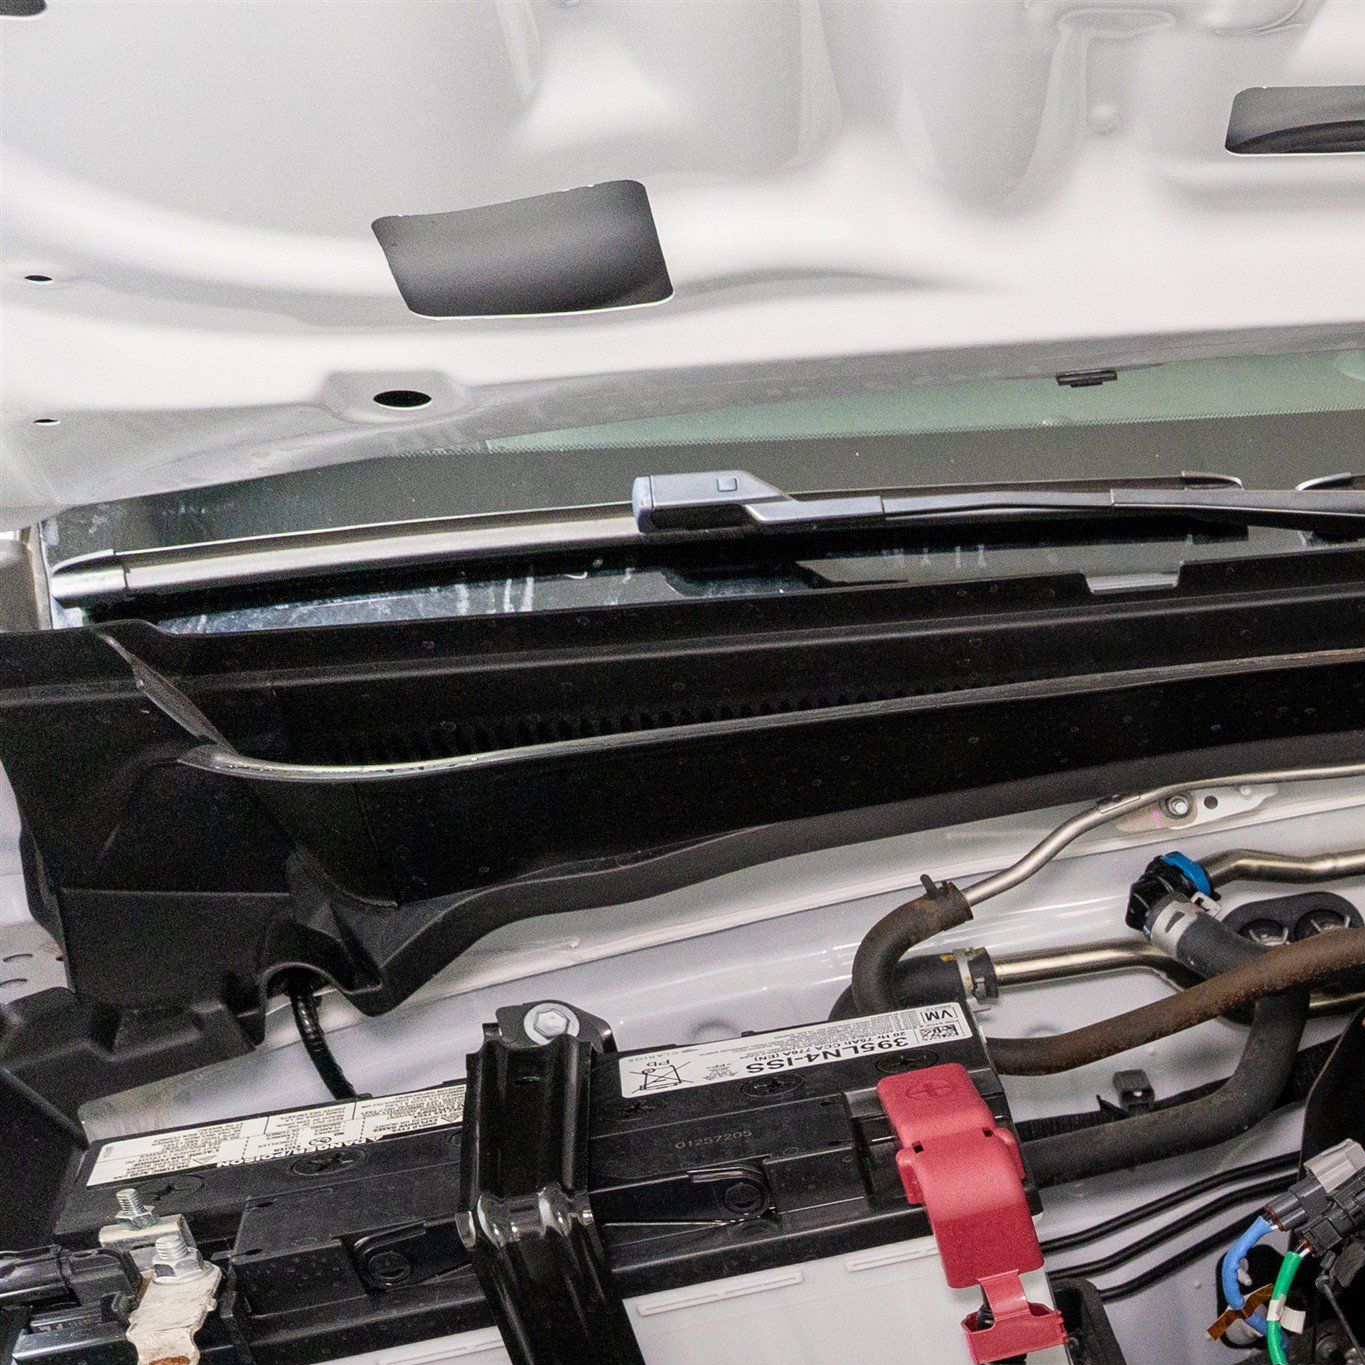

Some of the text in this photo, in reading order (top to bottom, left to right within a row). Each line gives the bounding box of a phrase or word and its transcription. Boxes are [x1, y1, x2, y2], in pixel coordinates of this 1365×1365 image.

[923, 1008, 953, 1021] VM
[813, 1042, 841, 1051] CCA
[743, 1035, 910, 1074] 395LN4-ISS
[644, 1058, 670, 1068] Pb
